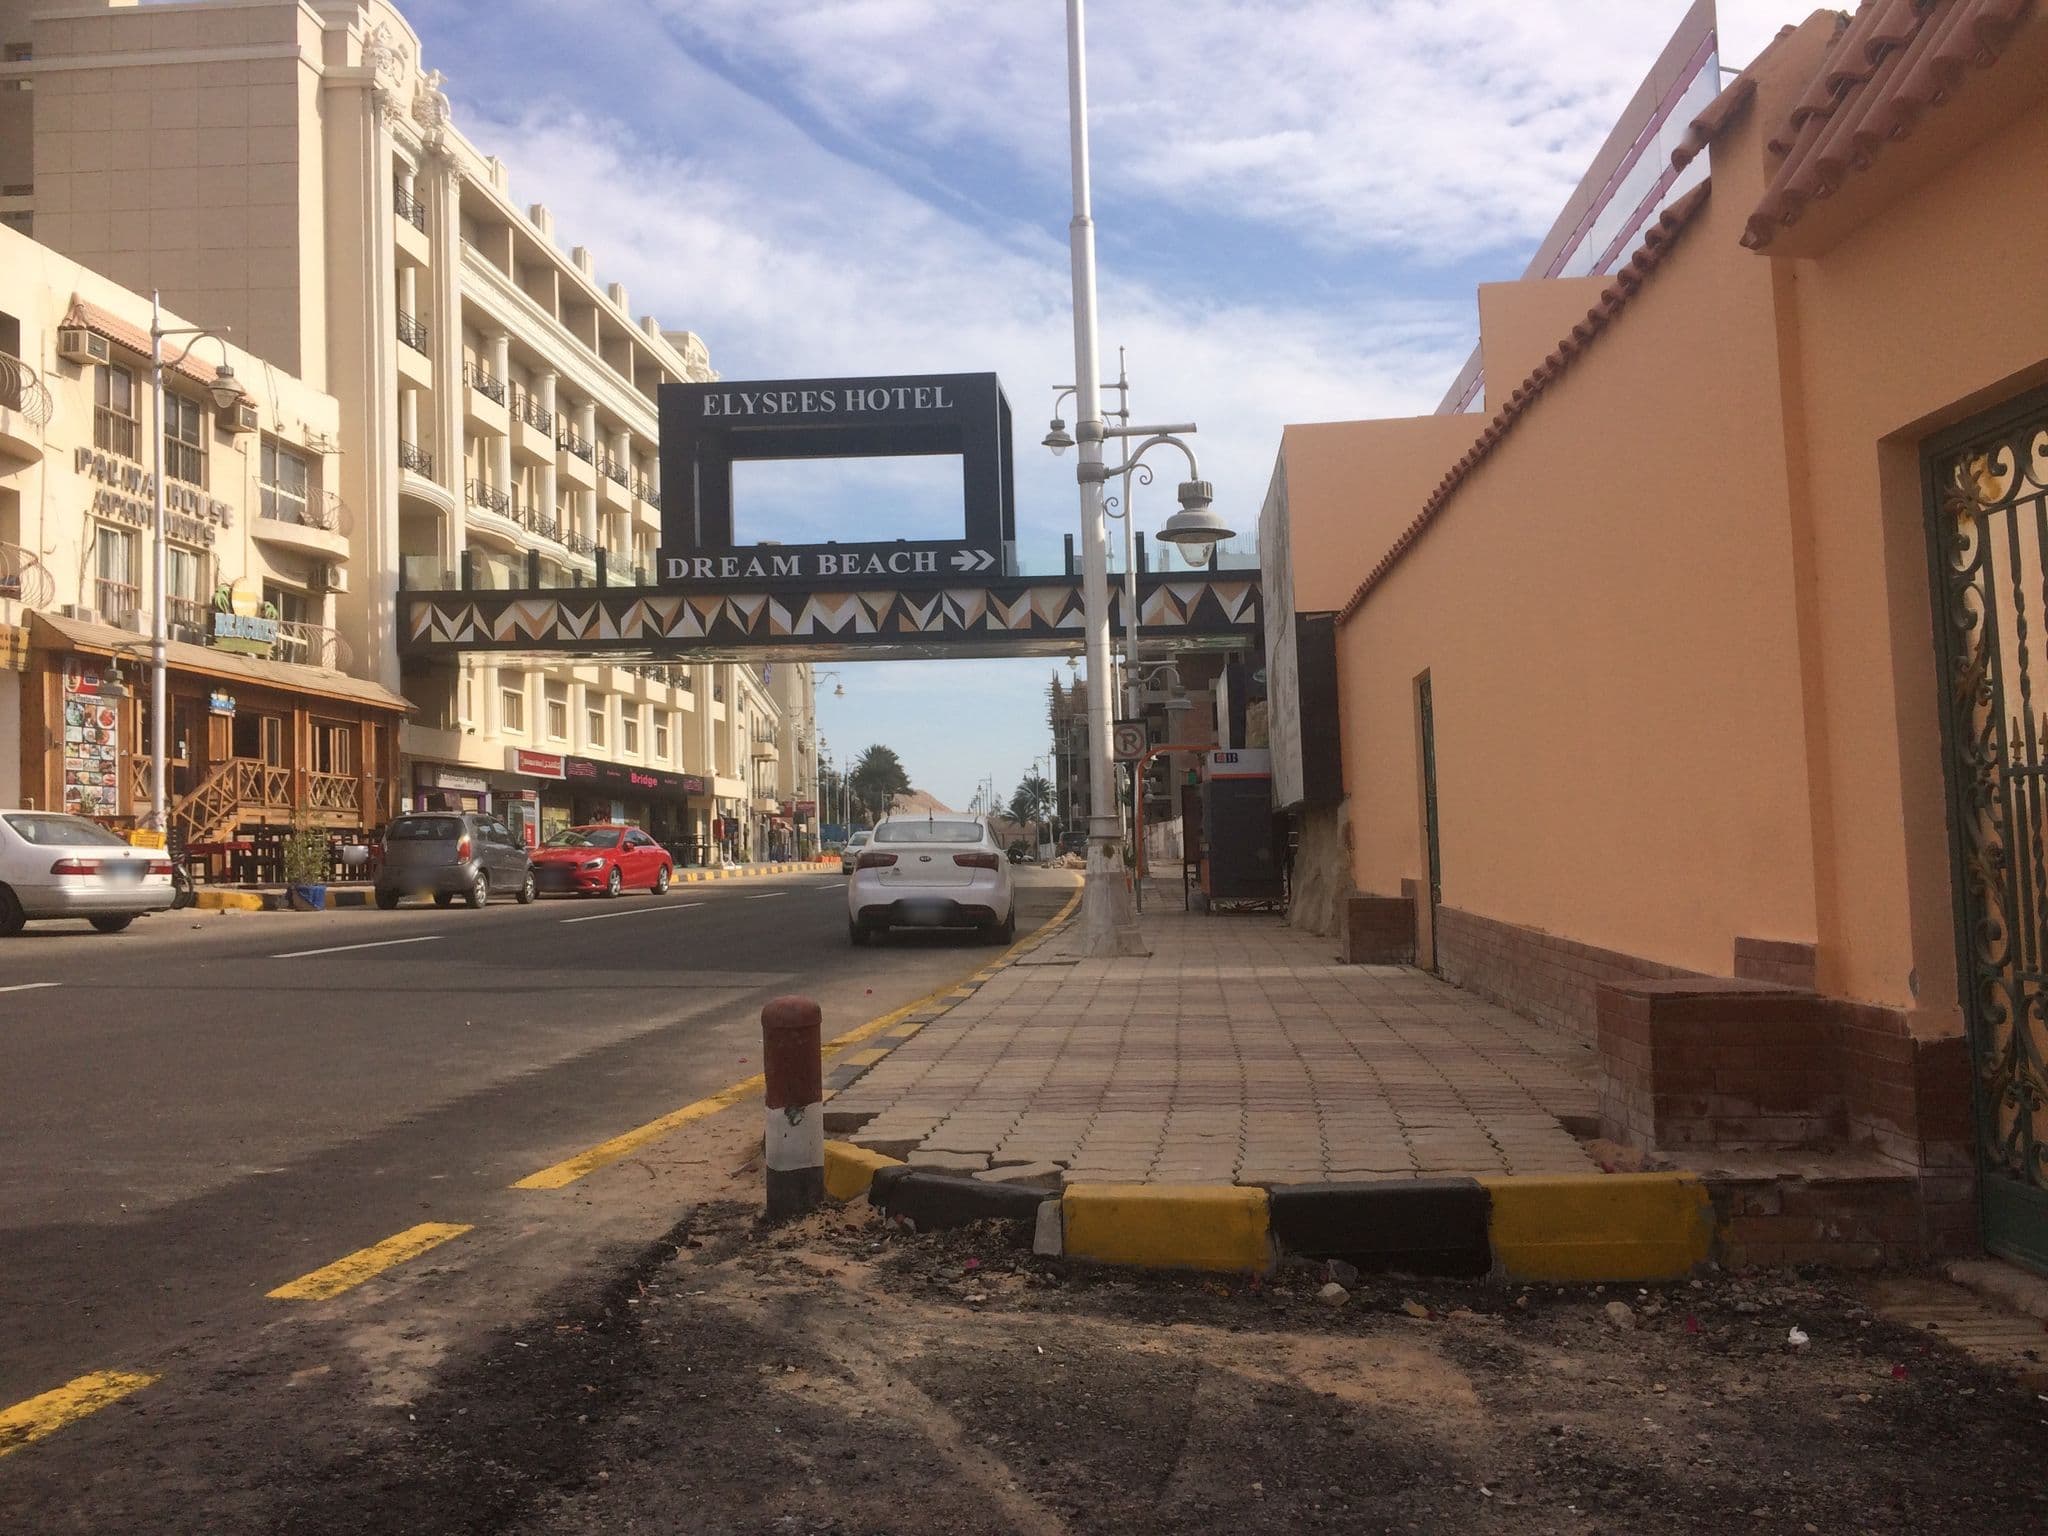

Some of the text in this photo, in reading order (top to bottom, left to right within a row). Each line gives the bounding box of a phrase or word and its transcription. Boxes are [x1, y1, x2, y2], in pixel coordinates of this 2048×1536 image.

[703, 386, 953, 416] ELYSEES HOTEL
[166, 483, 234, 529] HOUSE
[666, 551, 938, 579] DREAM BEACH
[630, 772, 658, 788] Bridge
